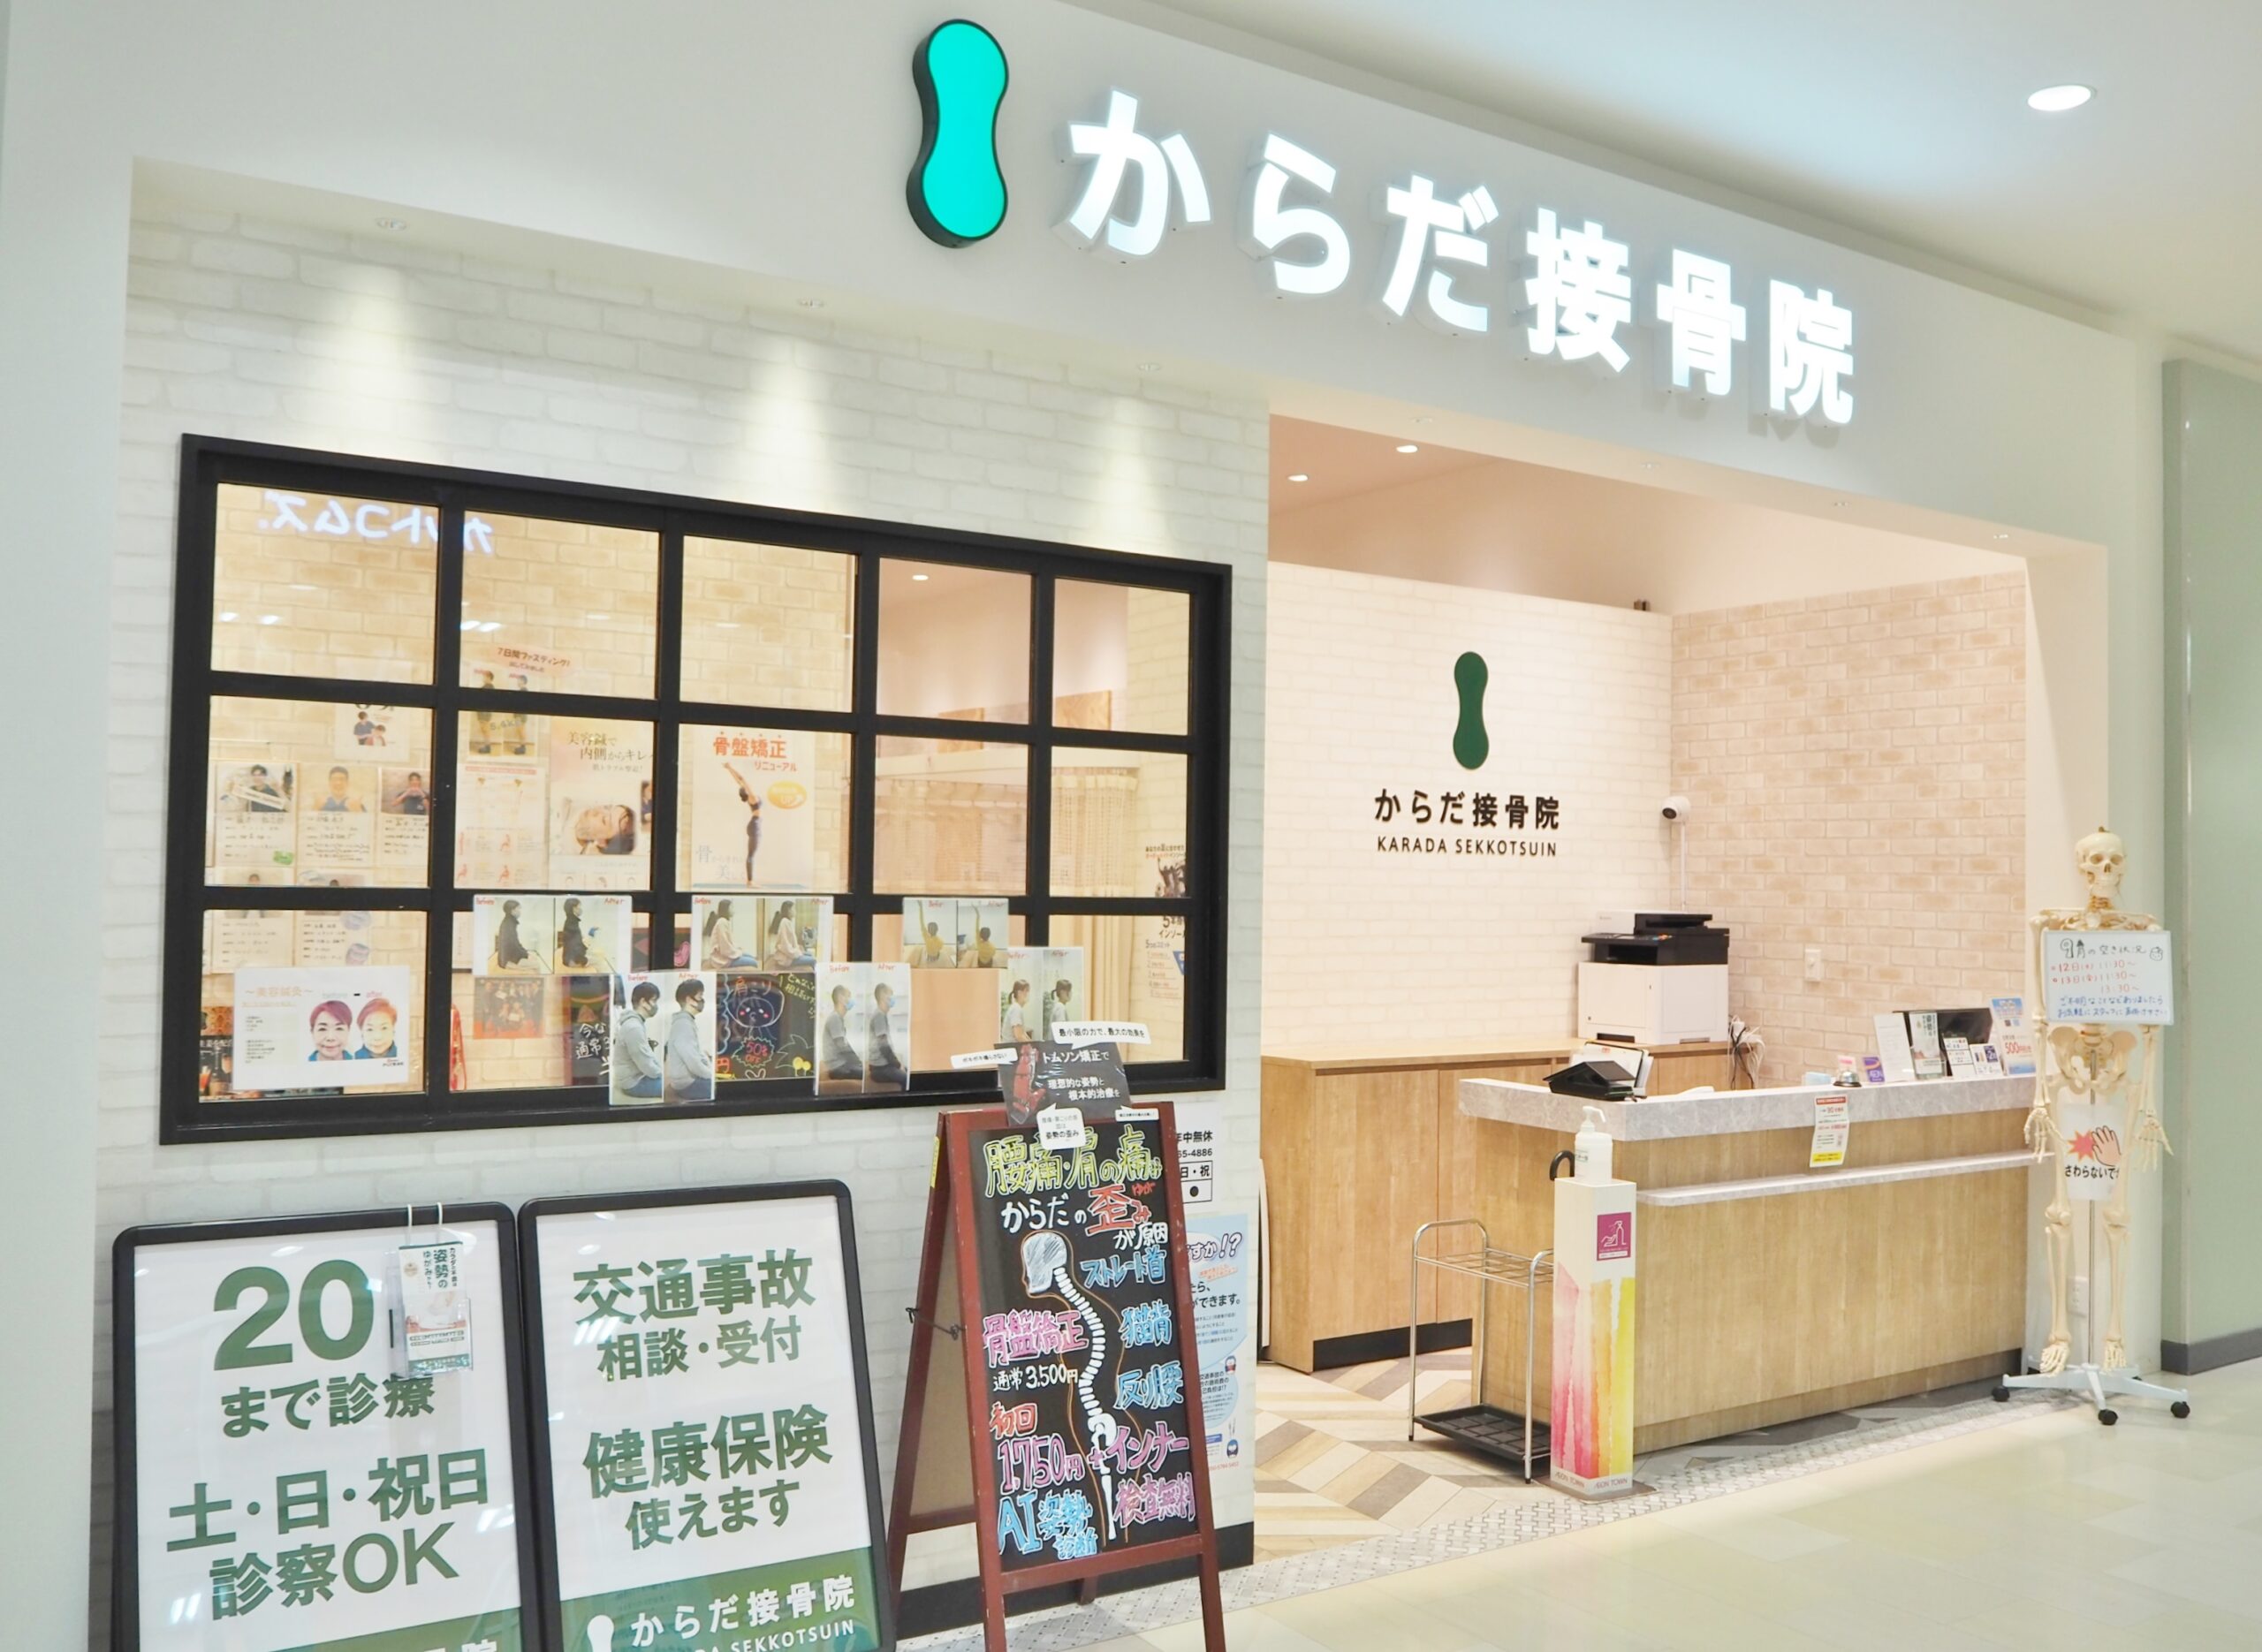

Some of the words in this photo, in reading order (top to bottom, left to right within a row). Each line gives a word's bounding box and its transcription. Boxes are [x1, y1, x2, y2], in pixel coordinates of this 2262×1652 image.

[1067, 86, 1854, 425] からだ接骨院
[713, 737, 786, 758] 骨盤矯正
[755, 761, 797, 772] リニューアル
[1374, 788, 1560, 830] からだ接骨院
[1378, 836, 1447, 853] KARADA
[1455, 838, 1557, 857] SEKKOTSUIN
[1000, 1184, 1152, 1237] からだの歪み
[1113, 1222, 1169, 1250] が原因
[573, 1247, 816, 1326] 交通事故
[1080, 1244, 1166, 1289] ストレート首
[213, 1259, 375, 1370] 20
[1119, 1300, 1173, 1348] 猫背
[1195, 1292, 1241, 1308] できます。
[596, 1315, 802, 1382] 相談・受付
[983, 1308, 1089, 1368] 骨盤矯正
[221, 1372, 436, 1438] まで診療
[1114, 1360, 1185, 1411] 反り腰
[990, 1400, 1038, 1440] 初回
[582, 1404, 833, 1499] 健康保険
[166, 1449, 489, 1552] 土・日・祝日
[625, 1479, 801, 1551] 使えます
[1112, 1472, 1196, 1529] 検査無料
[209, 1521, 460, 1620] 診察OK
[630, 1573, 855, 1648] からだ接骨院
[731, 1618, 855, 1652] SEKKOTSUIN
